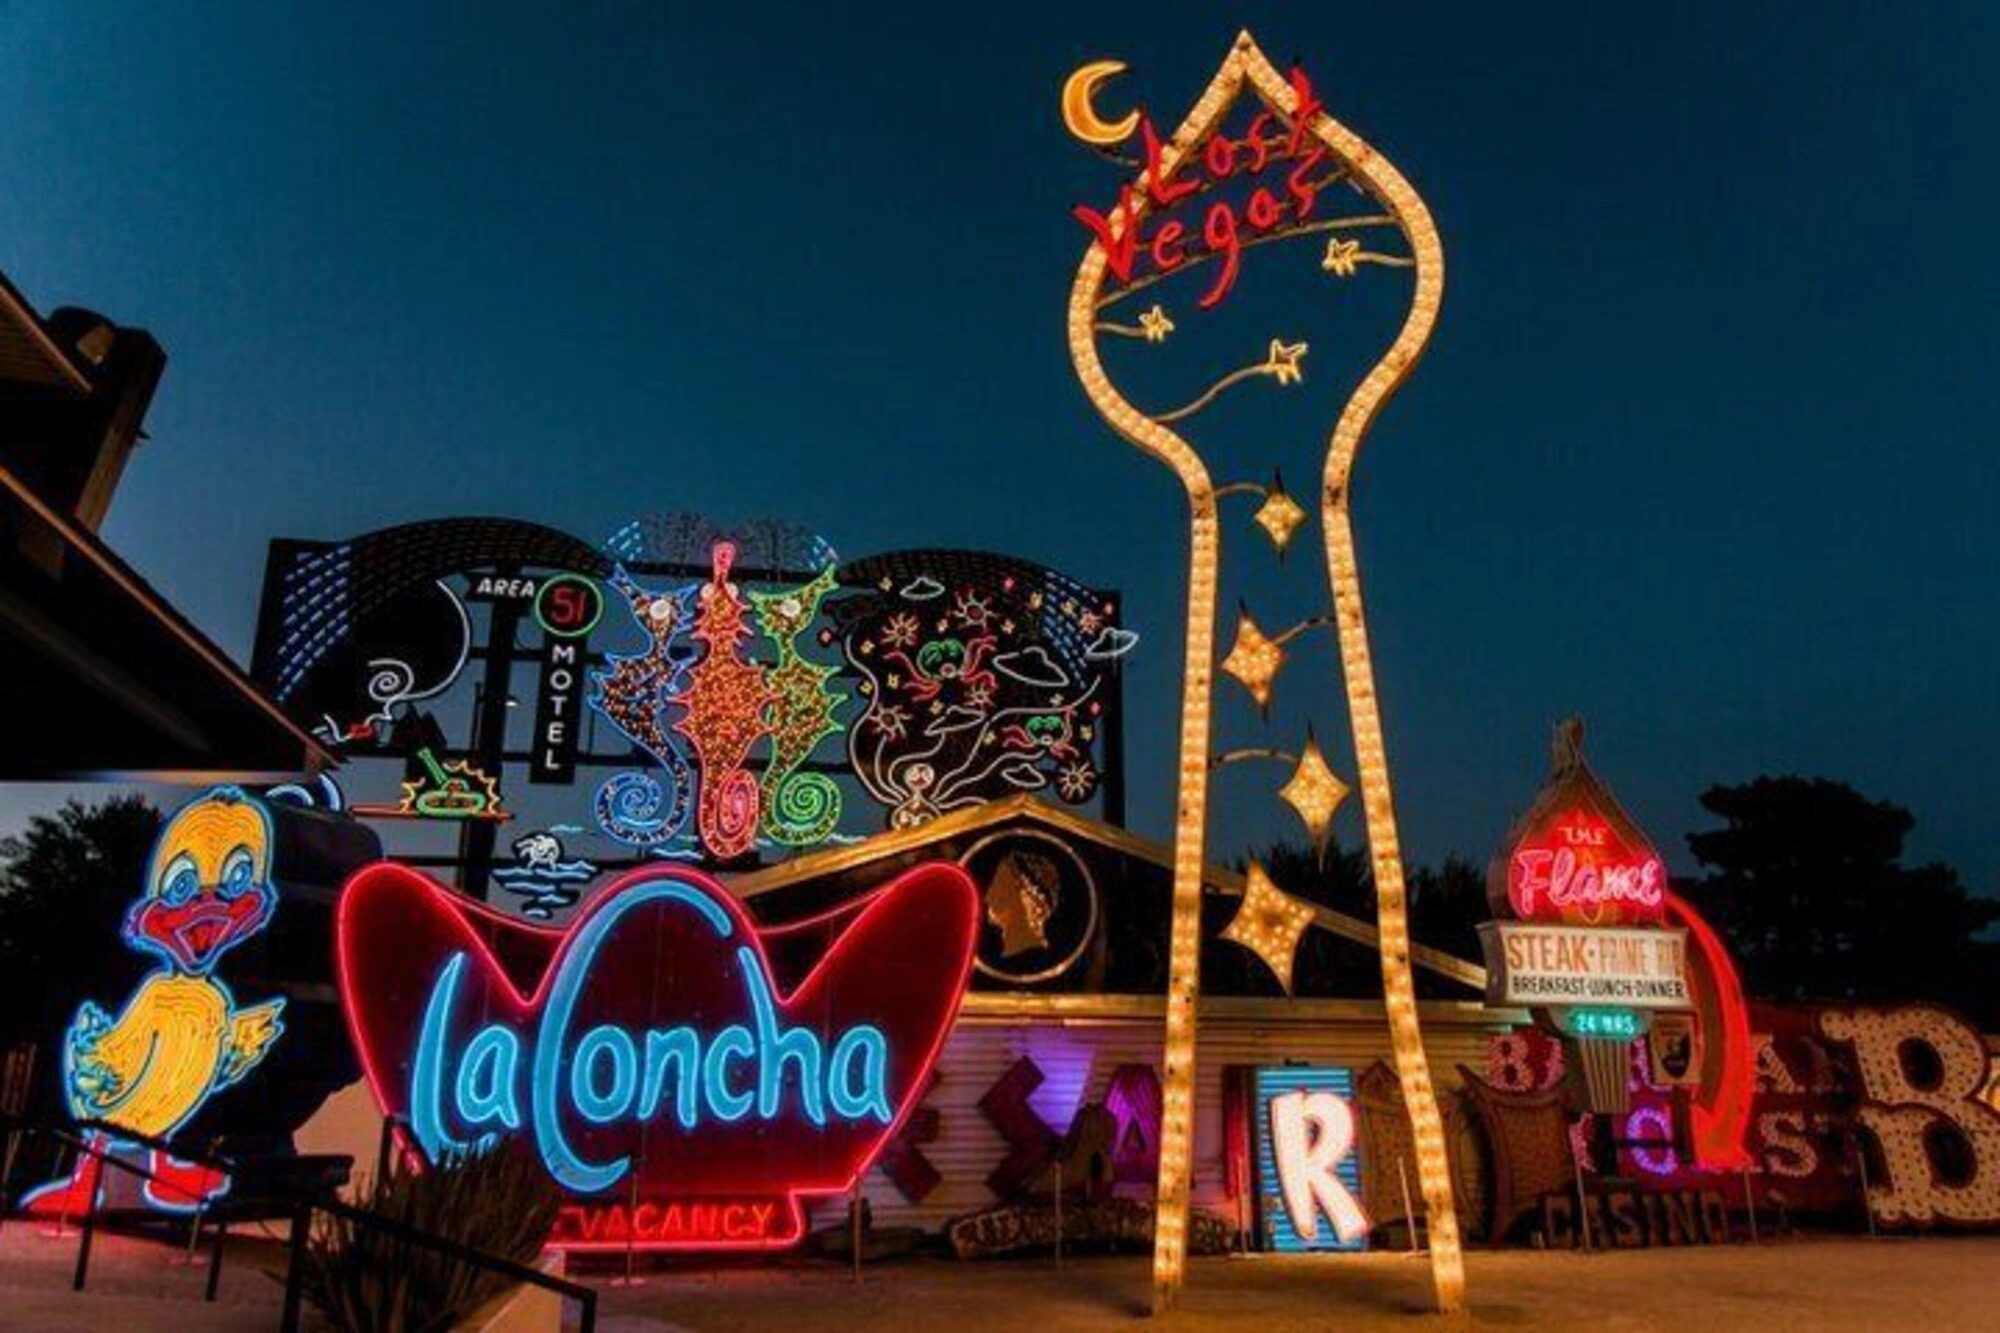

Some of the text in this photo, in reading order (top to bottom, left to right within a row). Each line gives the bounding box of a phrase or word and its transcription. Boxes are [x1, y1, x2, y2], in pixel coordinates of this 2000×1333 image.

[1139, 66, 1323, 205] Lost
[1073, 147, 1325, 310] Vegas
[477, 577, 587, 623] AREA 51
[545, 644, 576, 770] MOTEL
[1513, 846, 1662, 915] Flame
[1508, 933, 1589, 974] STEAK
[1512, 975, 1585, 996] BREAKFAST
[1637, 979, 1685, 999] DINNER
[532, 879, 894, 1194] Concha
[1271, 1087, 1371, 1247] R
[572, 1202, 774, 1240] VACANCY
